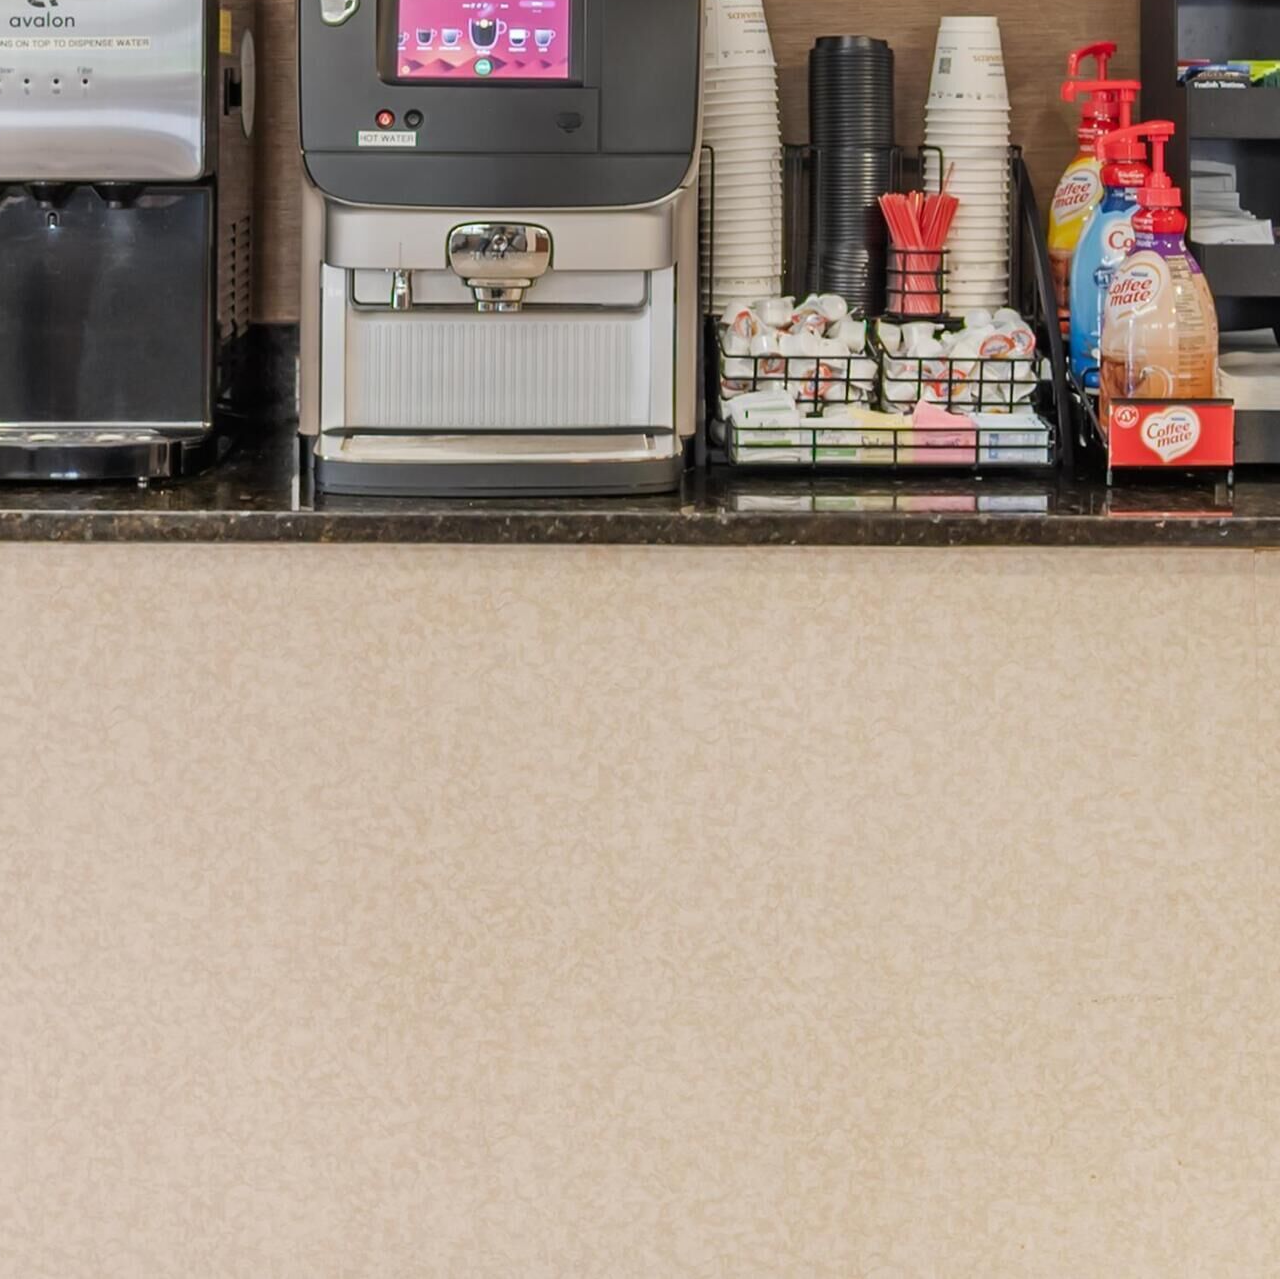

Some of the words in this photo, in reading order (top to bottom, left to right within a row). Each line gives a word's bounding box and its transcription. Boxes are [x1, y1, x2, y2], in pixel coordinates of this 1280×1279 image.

[9, 11, 76, 28] avalon
[15, 38, 30, 48] ON
[32, 38, 51, 48] TOP
[53, 38, 67, 48] TO
[68, 38, 114, 47] DISPENSE
[116, 38, 149, 47] WATER
[360, 134, 378, 143] HOT
[381, 134, 414, 143] WATER
[1110, 290, 1151, 307] mate
[1146, 423, 1191, 440] Coffee
[1157, 431, 1192, 448] mate
